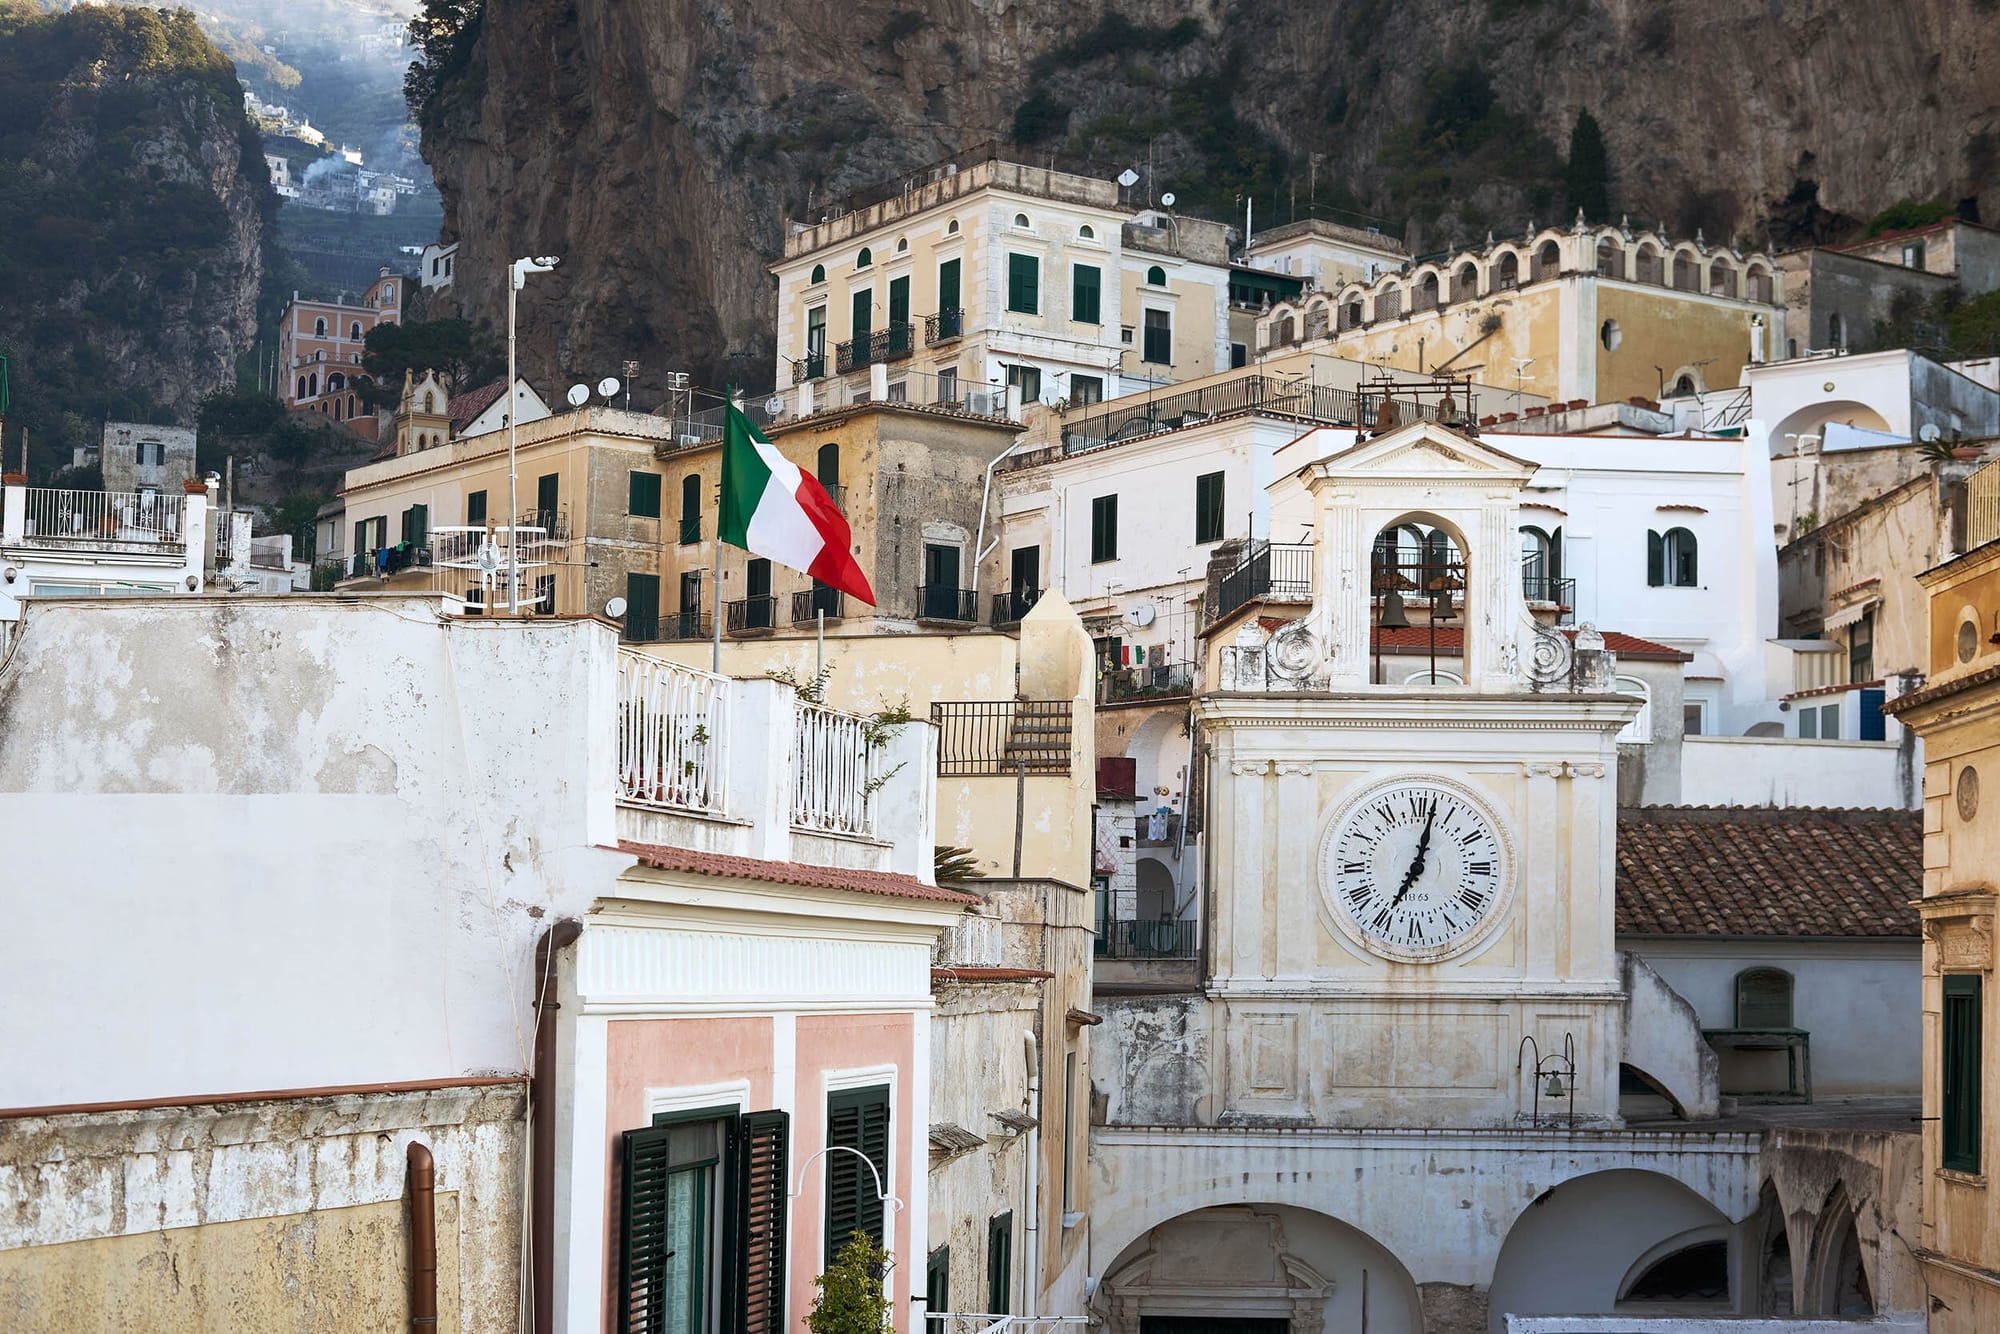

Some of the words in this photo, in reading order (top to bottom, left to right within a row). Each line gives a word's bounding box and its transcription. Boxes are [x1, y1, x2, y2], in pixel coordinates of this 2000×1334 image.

[1378, 804, 1396, 823] XI
[1410, 798, 1427, 817] XII
[1444, 807, 1456, 824] I
[1354, 830, 1373, 843] X
[1462, 830, 1482, 844] II
[1344, 862, 1364, 873] IX
[1470, 862, 1490, 875] III
[1350, 885, 1372, 911] VIII
[1459, 888, 1484, 911] IIII
[1373, 908, 1393, 932] VII
[1409, 918, 1423, 938] VI
[1443, 913, 1456, 929] V
